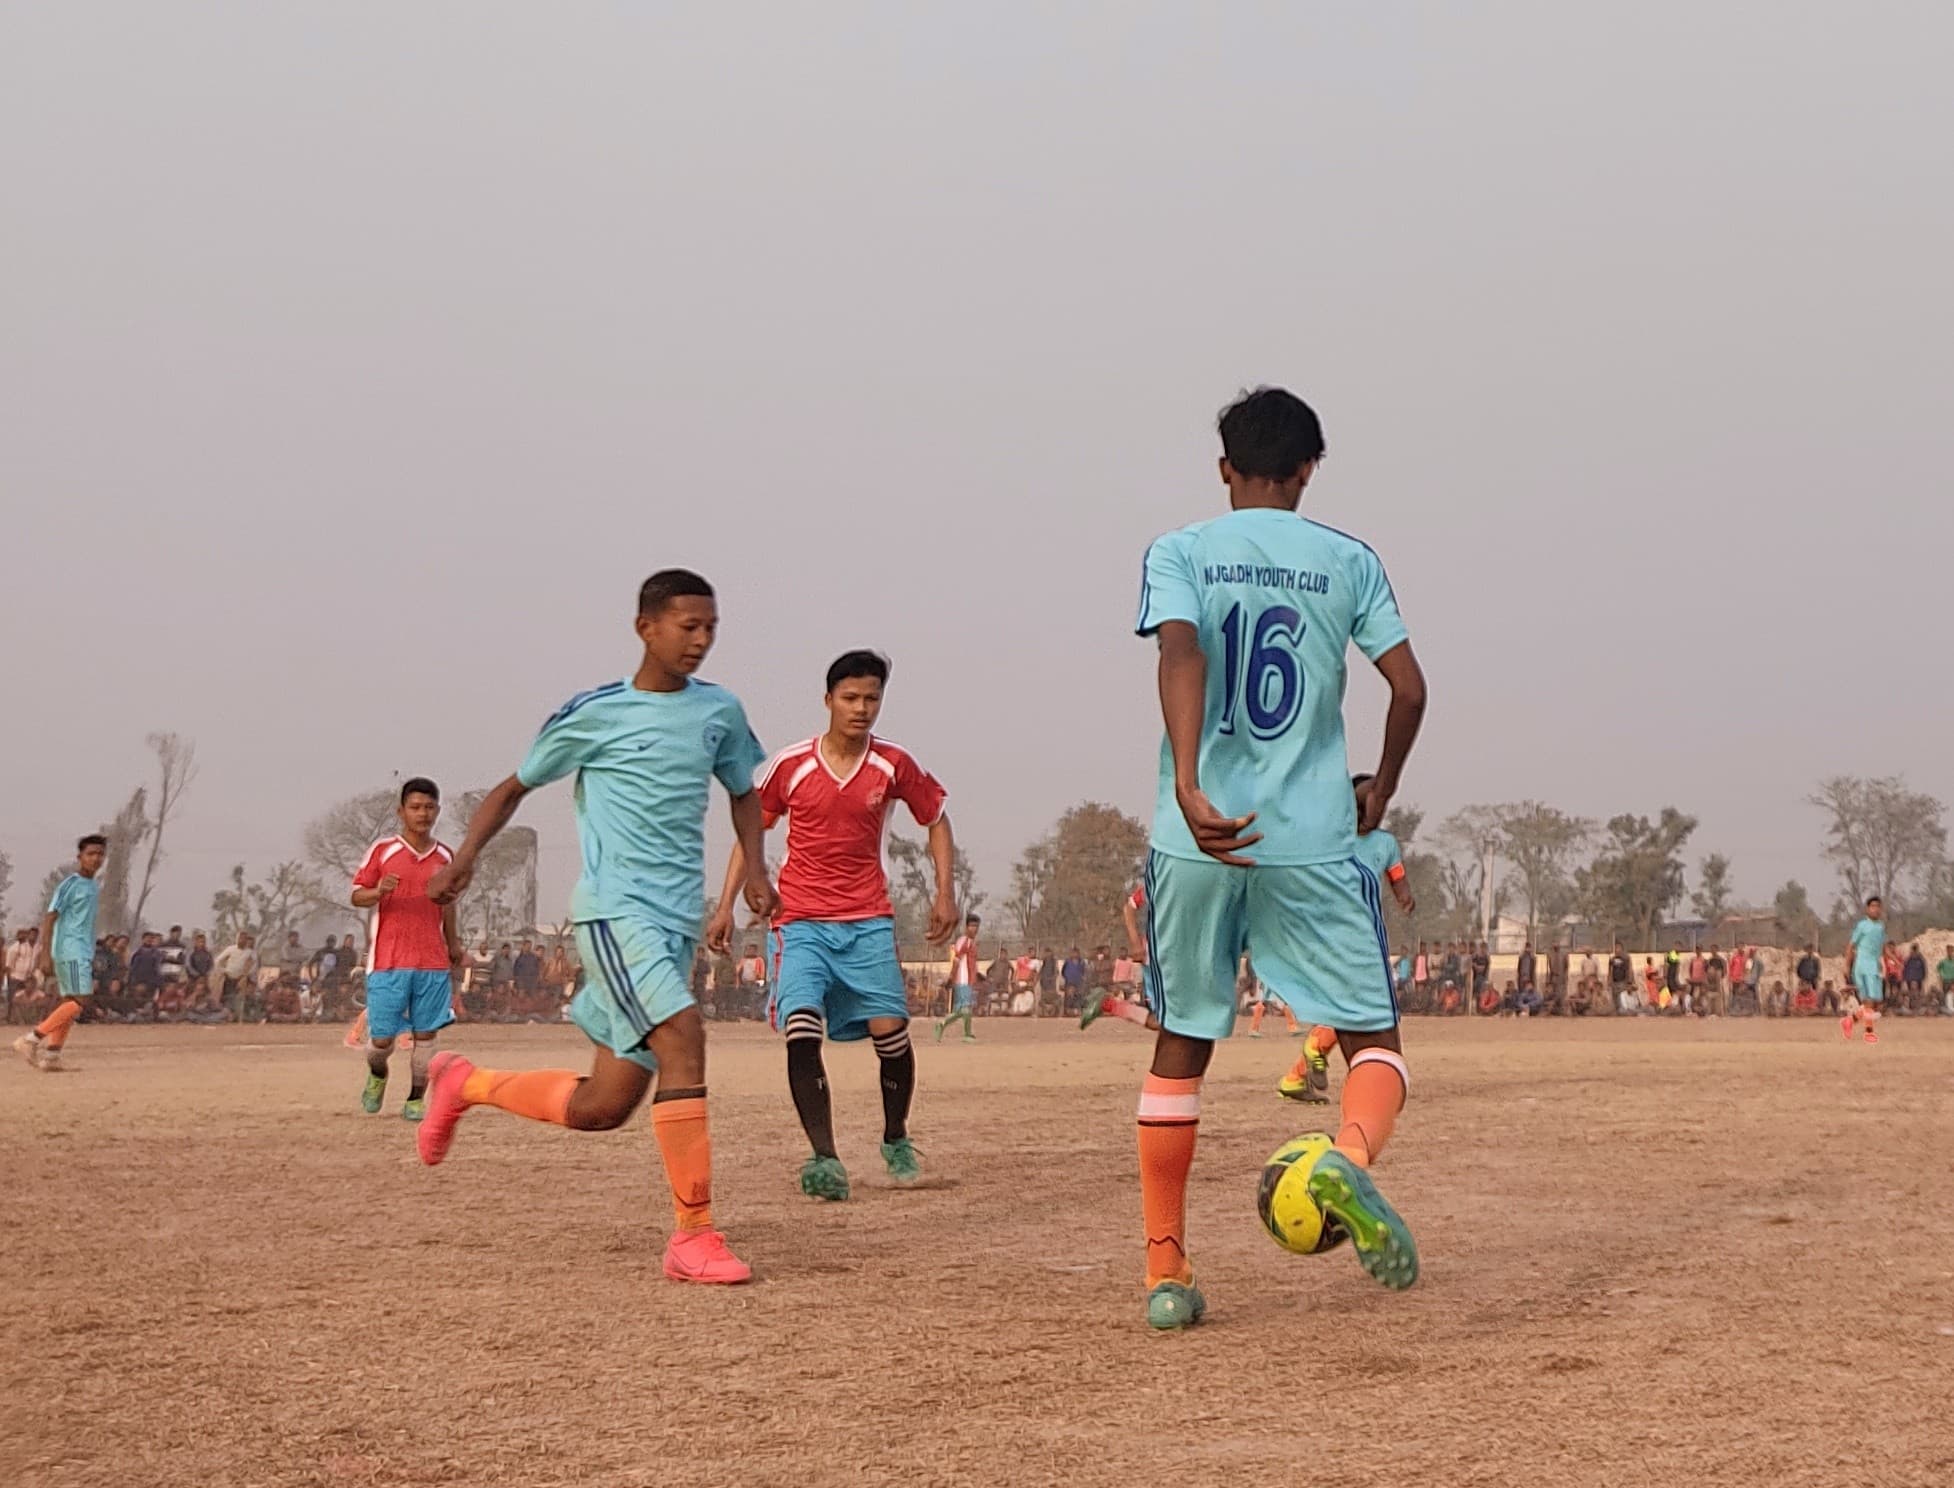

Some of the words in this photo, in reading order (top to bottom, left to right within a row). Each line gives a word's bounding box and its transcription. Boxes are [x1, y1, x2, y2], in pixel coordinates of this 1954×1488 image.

[1255, 566, 1296, 590] YOUTH
[1299, 571, 1329, 594] CLUB
[1219, 600, 1306, 740] 16
